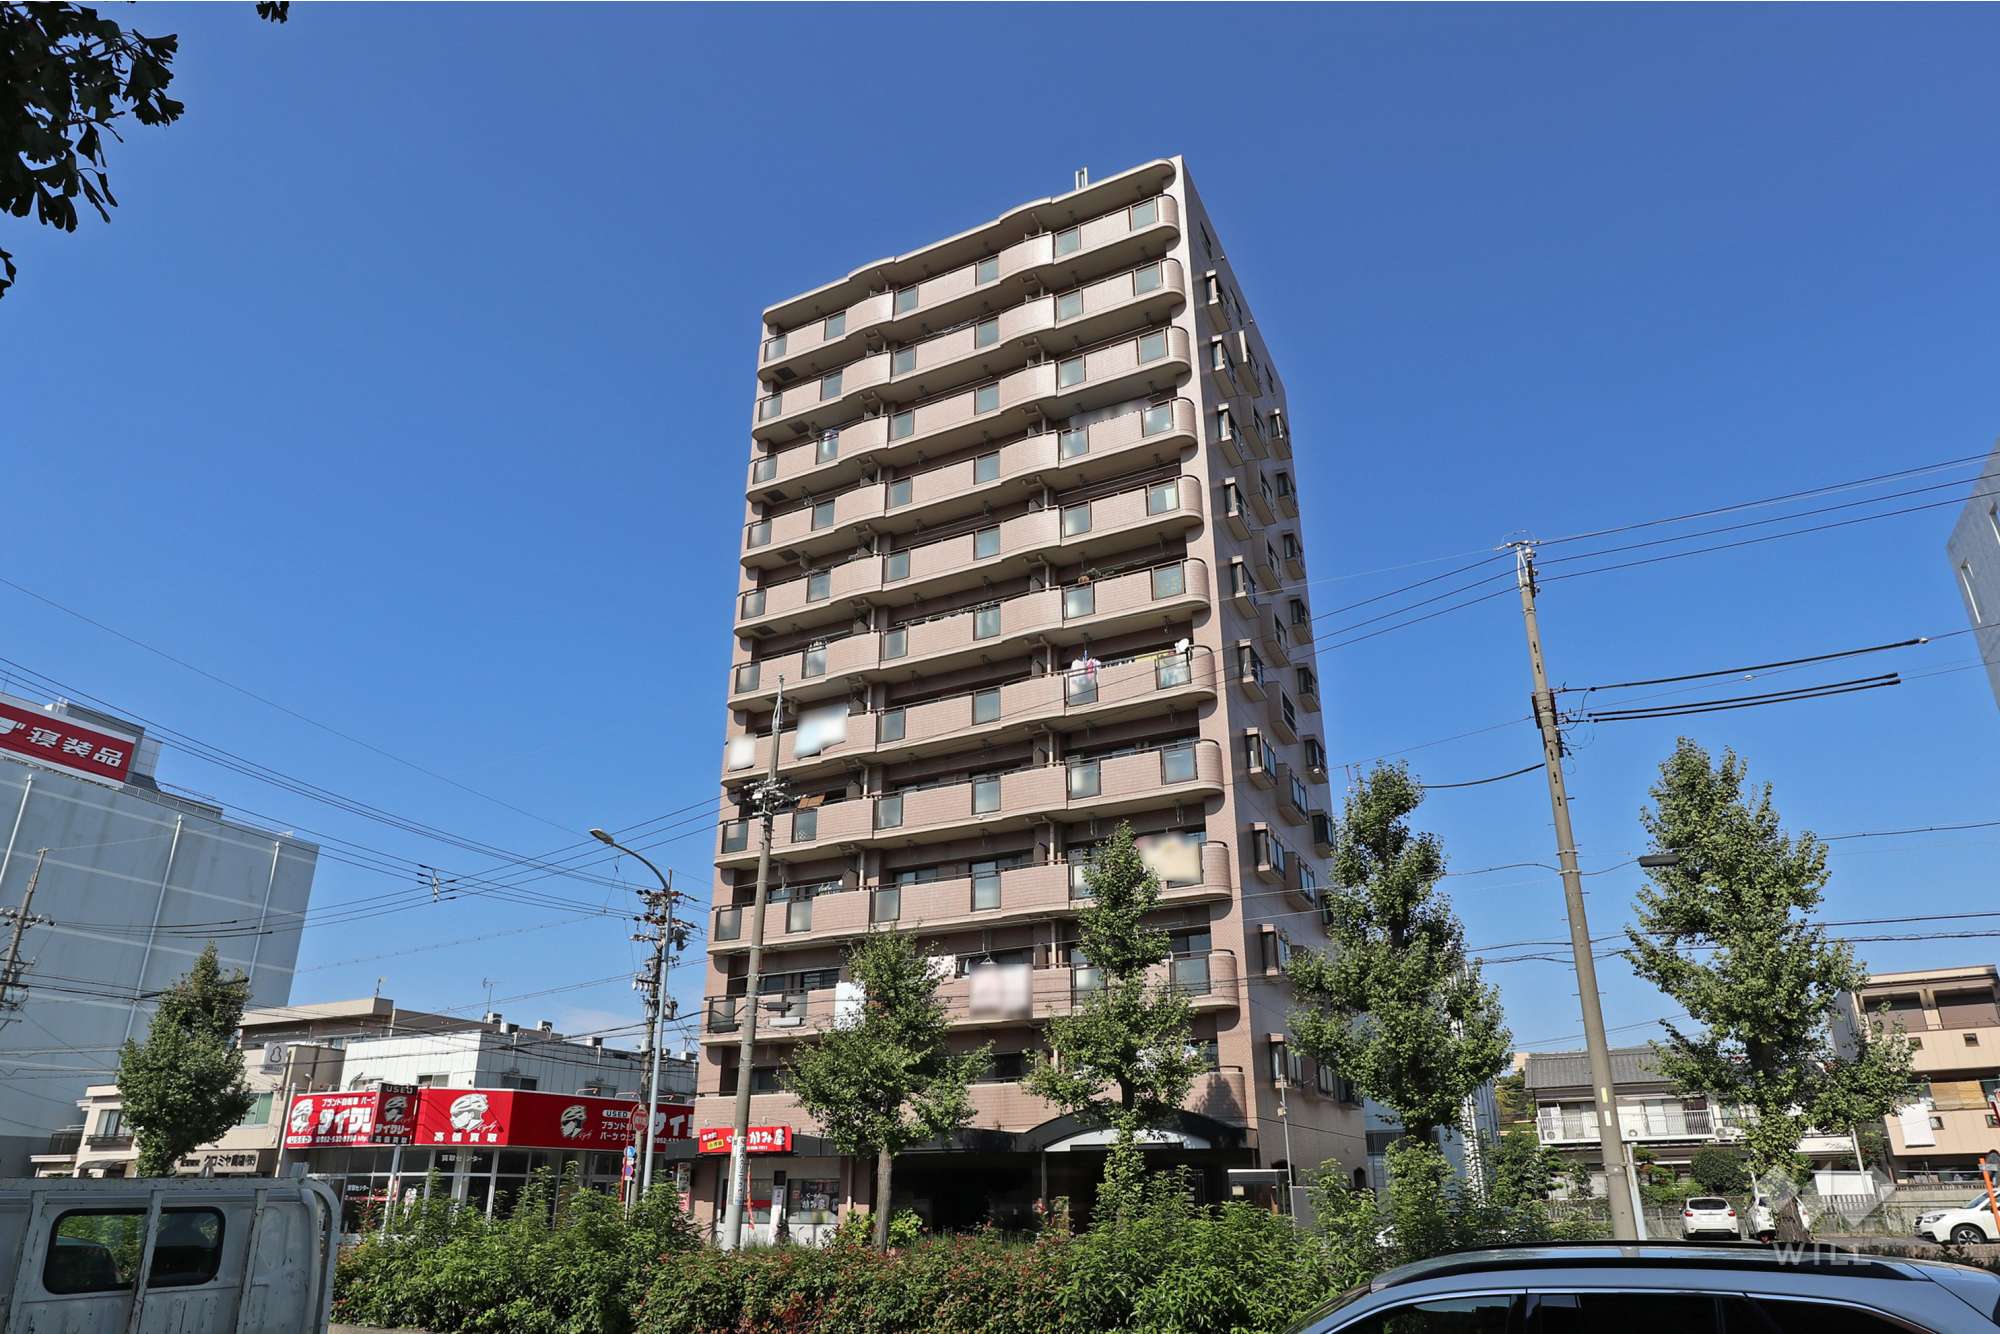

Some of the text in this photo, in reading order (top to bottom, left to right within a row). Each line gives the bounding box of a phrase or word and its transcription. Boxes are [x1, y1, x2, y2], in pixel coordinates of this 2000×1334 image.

[386, 1085, 413, 1094] USED
[606, 1110, 628, 1118] USED
[433, 1131, 498, 1142] 高価買取
